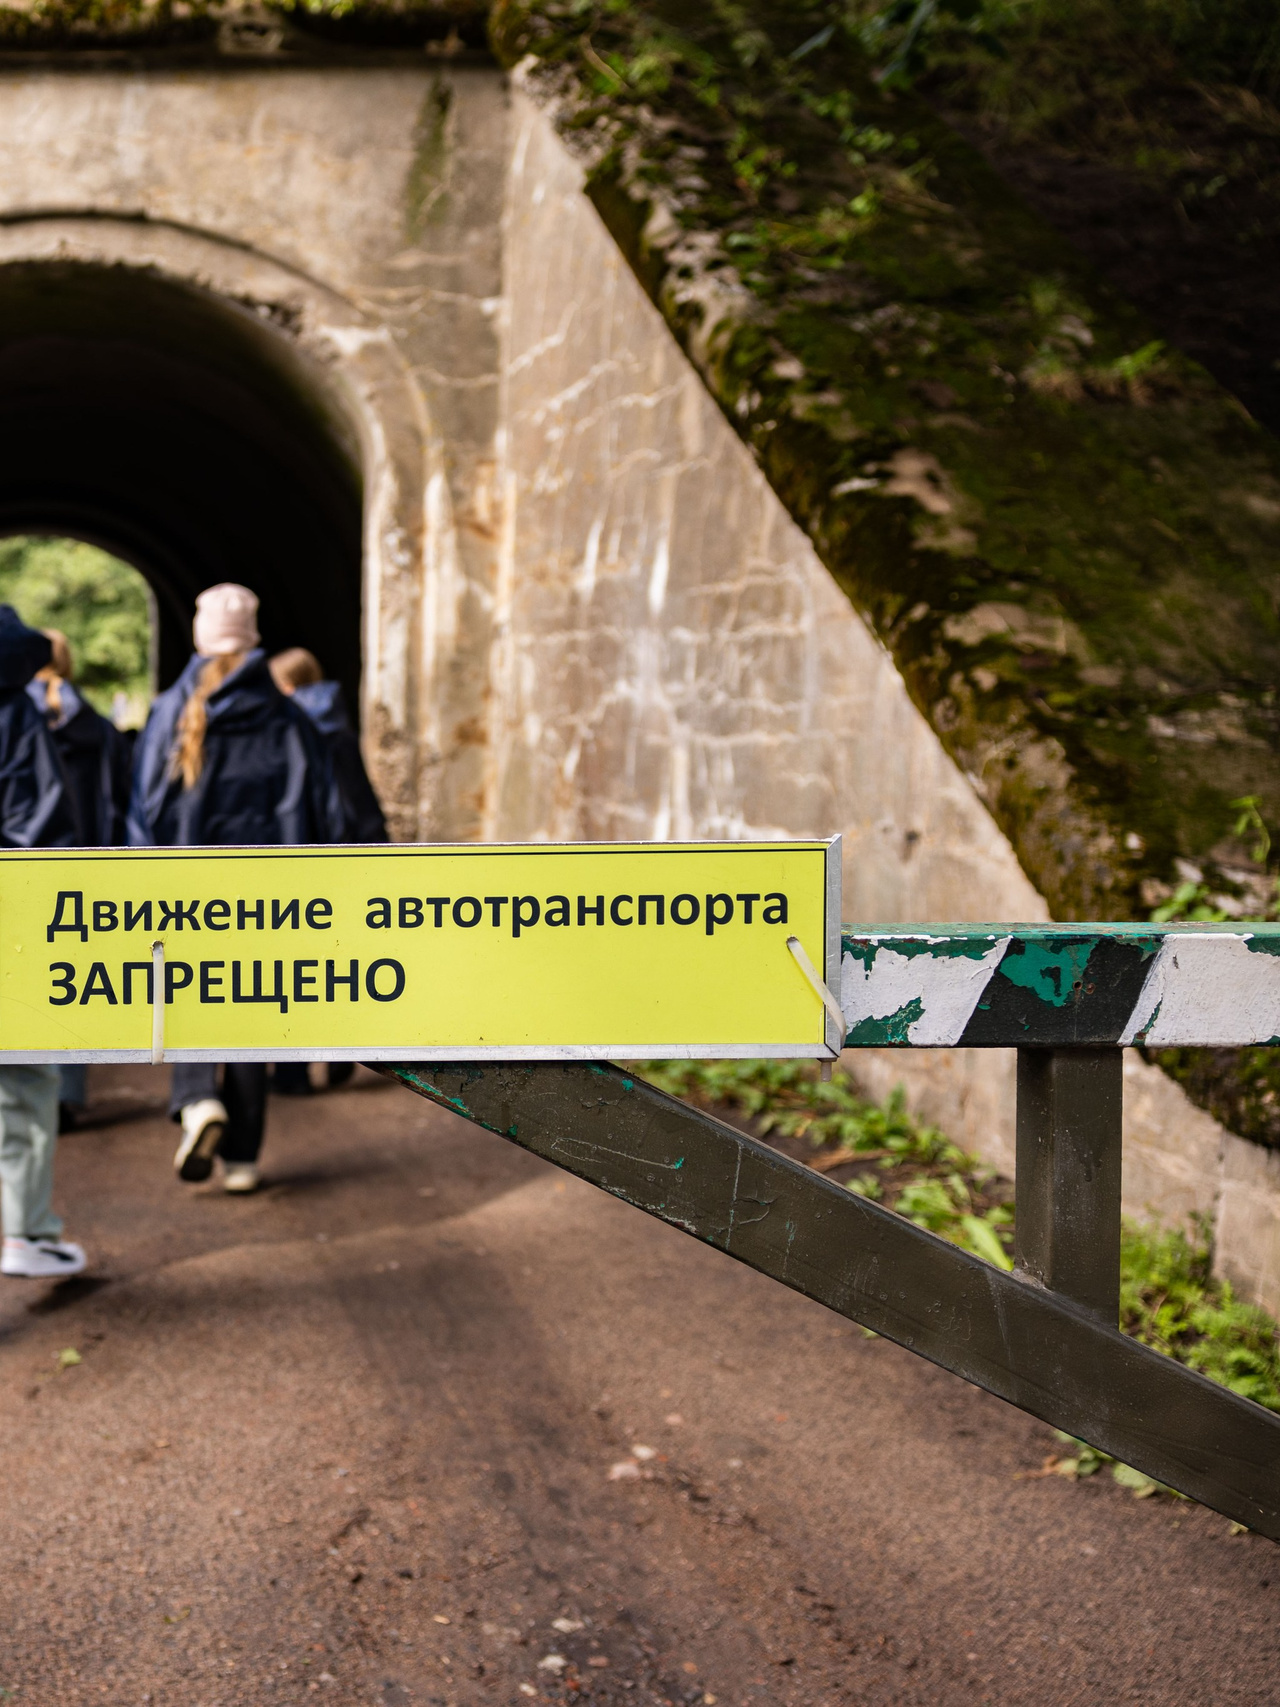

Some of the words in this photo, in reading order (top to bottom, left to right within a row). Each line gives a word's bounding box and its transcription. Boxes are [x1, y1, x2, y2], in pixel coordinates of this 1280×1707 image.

[46, 890, 333, 943] Движение
[365, 891, 788, 938] автотранспорта
[48, 958, 406, 1014] ЗАПРЕЩЕНО
